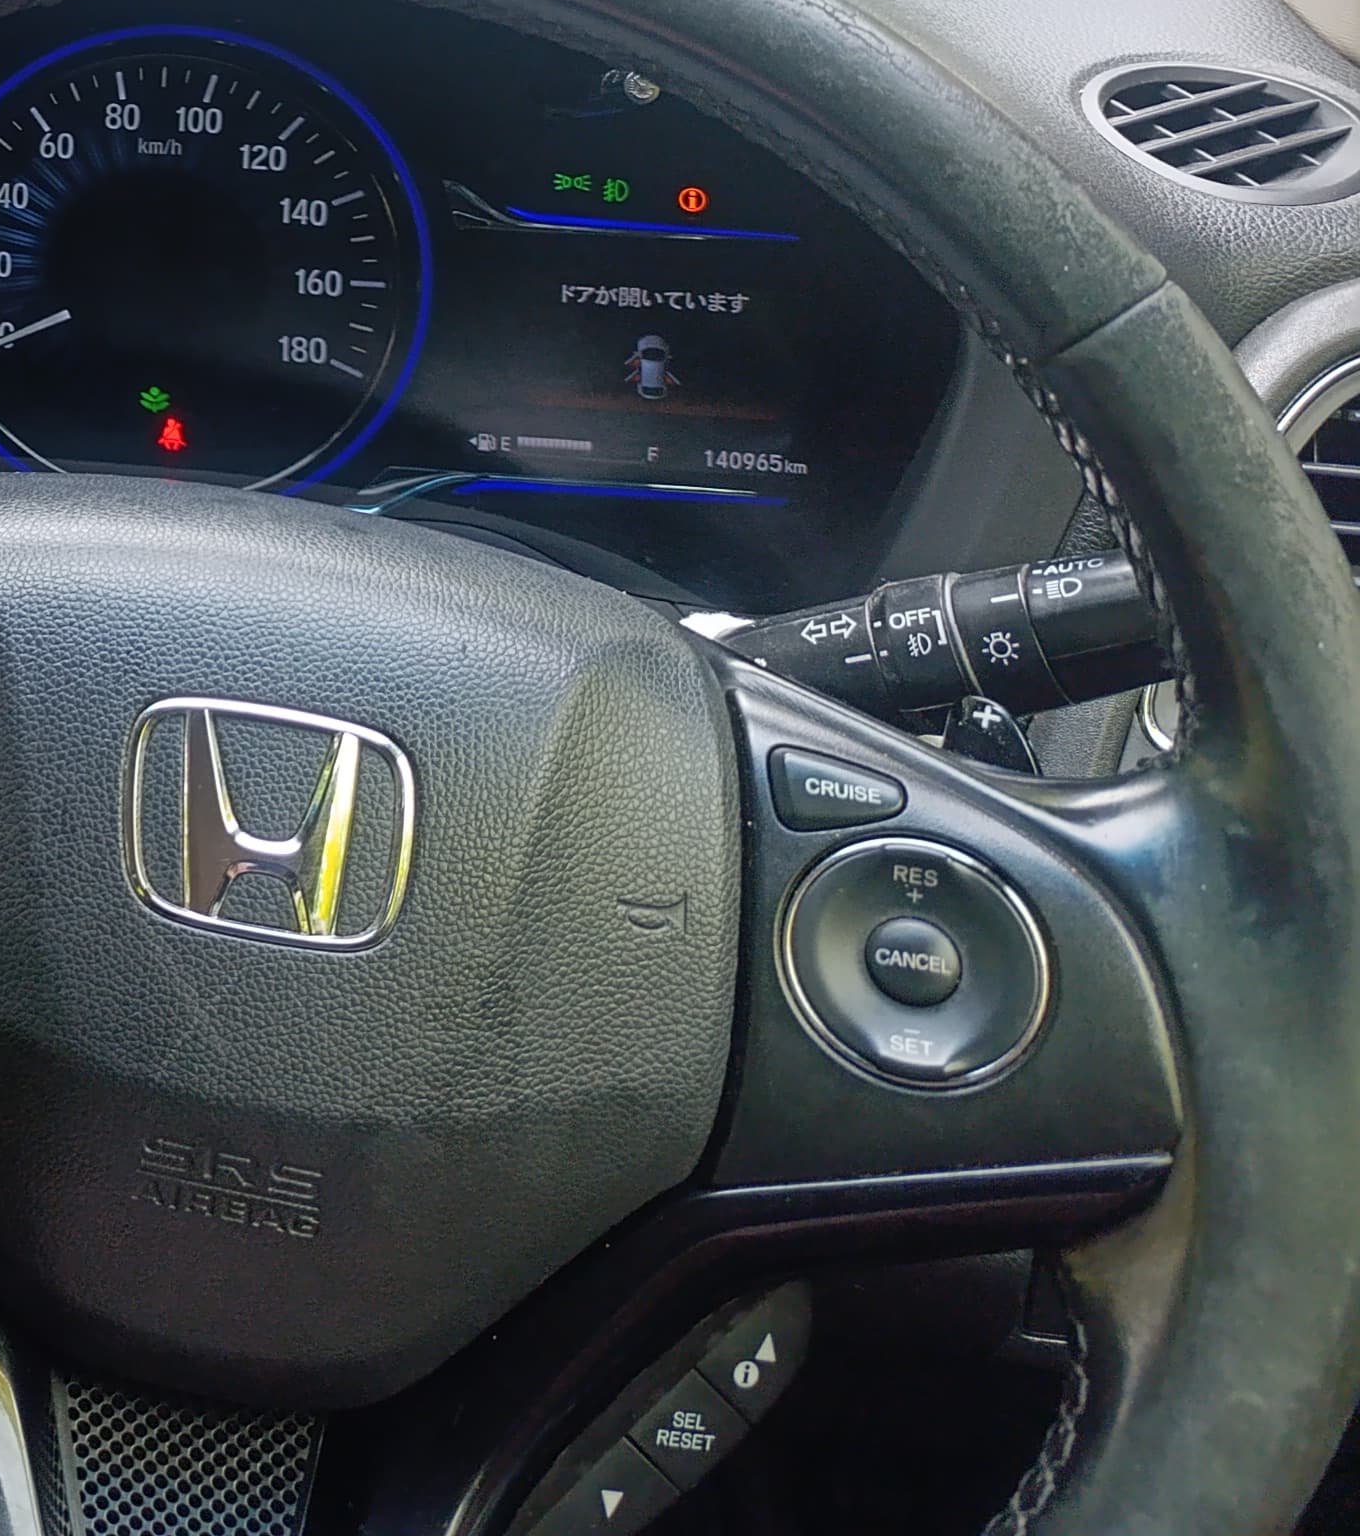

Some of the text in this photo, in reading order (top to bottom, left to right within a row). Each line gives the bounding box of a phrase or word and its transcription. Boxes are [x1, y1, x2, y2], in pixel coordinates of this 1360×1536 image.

[104, 103, 140, 130] 80
[176, 107, 223, 134] 100
[39, 132, 74, 160] 60
[137, 137, 182, 156] km/h
[239, 144, 287, 172] 120
[279, 198, 328, 227] 140
[294, 269, 343, 298] 160
[561, 284, 749, 313] ドアが開いています
[278, 336, 327, 364] 180
[500, 436, 511, 452] E
[647, 447, 658, 462] F
[1043, 558, 1104, 576] AUTO
[889, 608, 931, 630] OFF
[805, 777, 882, 805] CRUISE
[893, 865, 938, 887] RES
[875, 948, 953, 973] CANCEL
[889, 1034, 933, 1056] SET
[140, 1138, 322, 1198] SRS
[129, 1180, 321, 1239] AIRBAG
[672, 1411, 706, 1431] SEL
[656, 1429, 716, 1452] RESET
